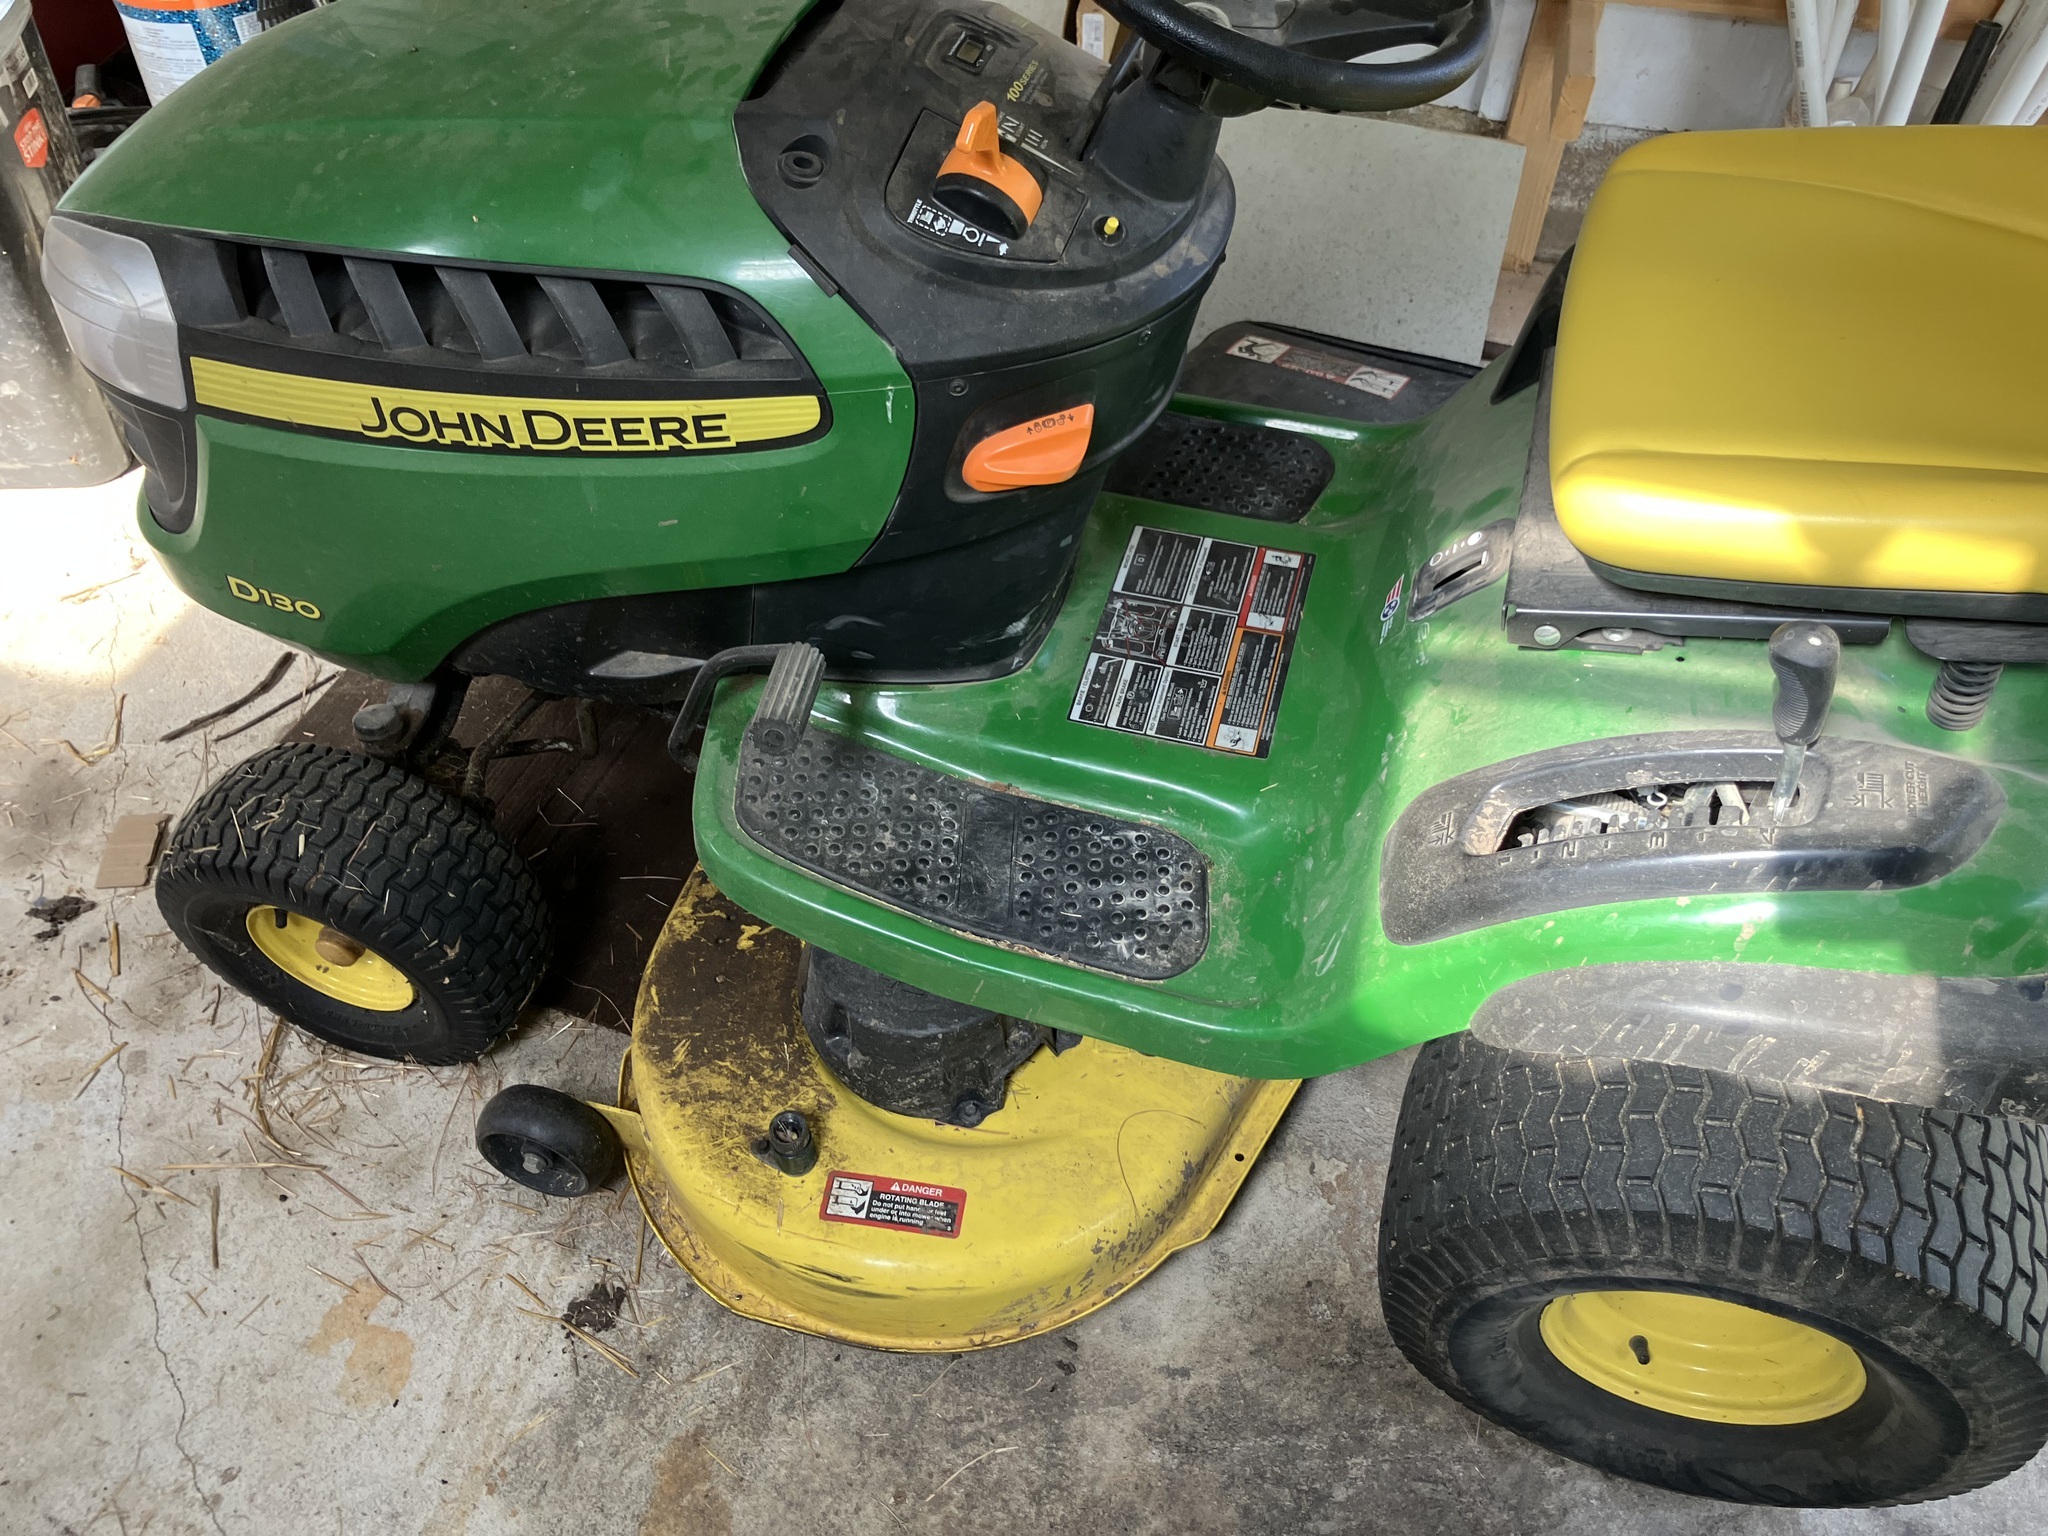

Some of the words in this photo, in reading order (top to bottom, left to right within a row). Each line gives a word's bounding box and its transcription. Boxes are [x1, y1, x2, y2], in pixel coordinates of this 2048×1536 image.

[1007, 81, 1024, 102] 100
[1020, 60, 1039, 85] SERIES
[1015, 122, 1025, 138] START
[906, 199, 923, 224] THROTTLE
[360, 396, 512, 445] JOHN
[521, 409, 732, 447] DEERE
[225, 575, 321, 620] D130
[1076, 689, 1085, 705] BRAKE
[1082, 668, 1092, 686] CLUTCH
[1119, 679, 1128, 693] BRAKE
[1222, 670, 1231, 690] WARNING
[1905, 760, 1915, 780] CUT
[1917, 771, 1929, 806] HEIGHT
[879, 1192, 917, 1204] ROTATING
[901, 1183, 942, 1196] DANGER
[870, 1206, 890, 1214] under
[893, 1203, 905, 1211] put
[869, 1212, 891, 1221] engine
[898, 1216, 923, 1226] running
